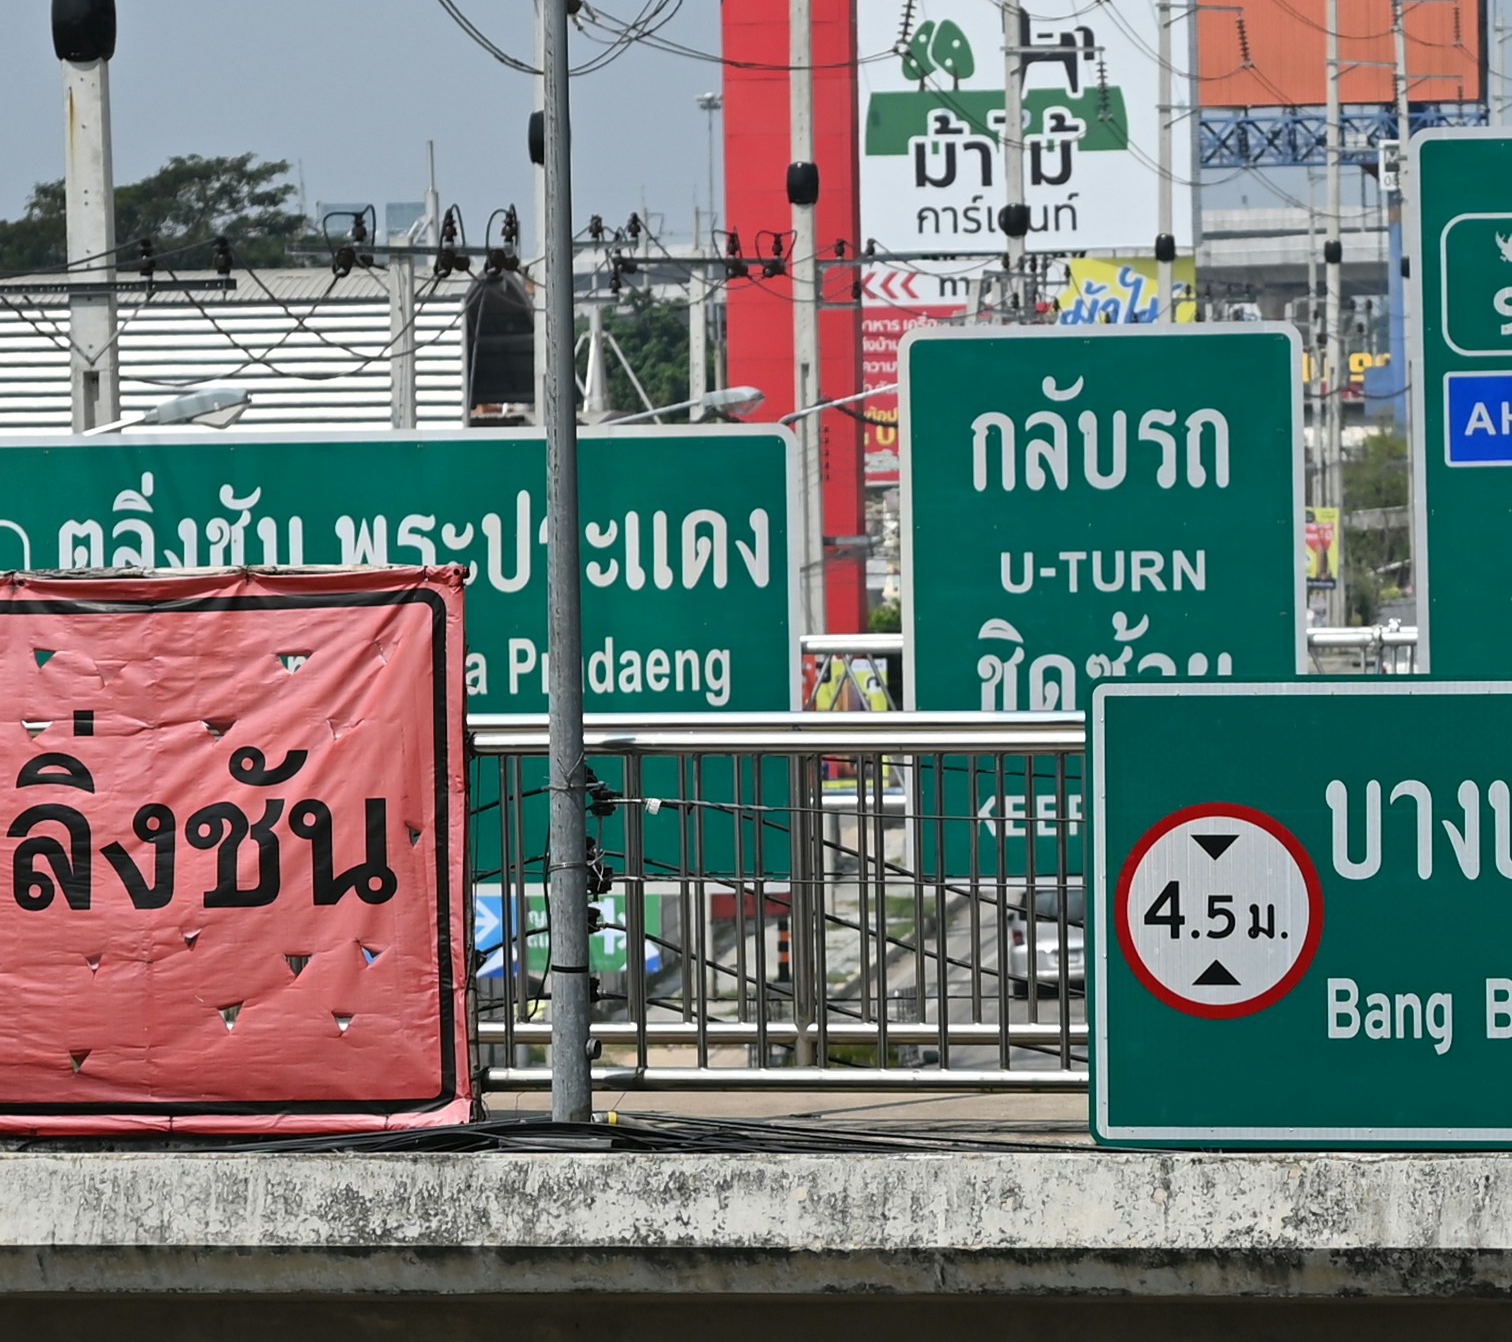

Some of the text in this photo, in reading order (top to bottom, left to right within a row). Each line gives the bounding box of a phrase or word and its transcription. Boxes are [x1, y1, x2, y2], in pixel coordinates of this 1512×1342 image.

[917, 192, 1079, 235] การ์เนท์
[971, 375, 1230, 492] กลับรถ
[335, 490, 770, 593] พระปะแดง
[1000, 549, 1207, 594] U-TURN
[1327, 977, 1454, 1056] Bang
